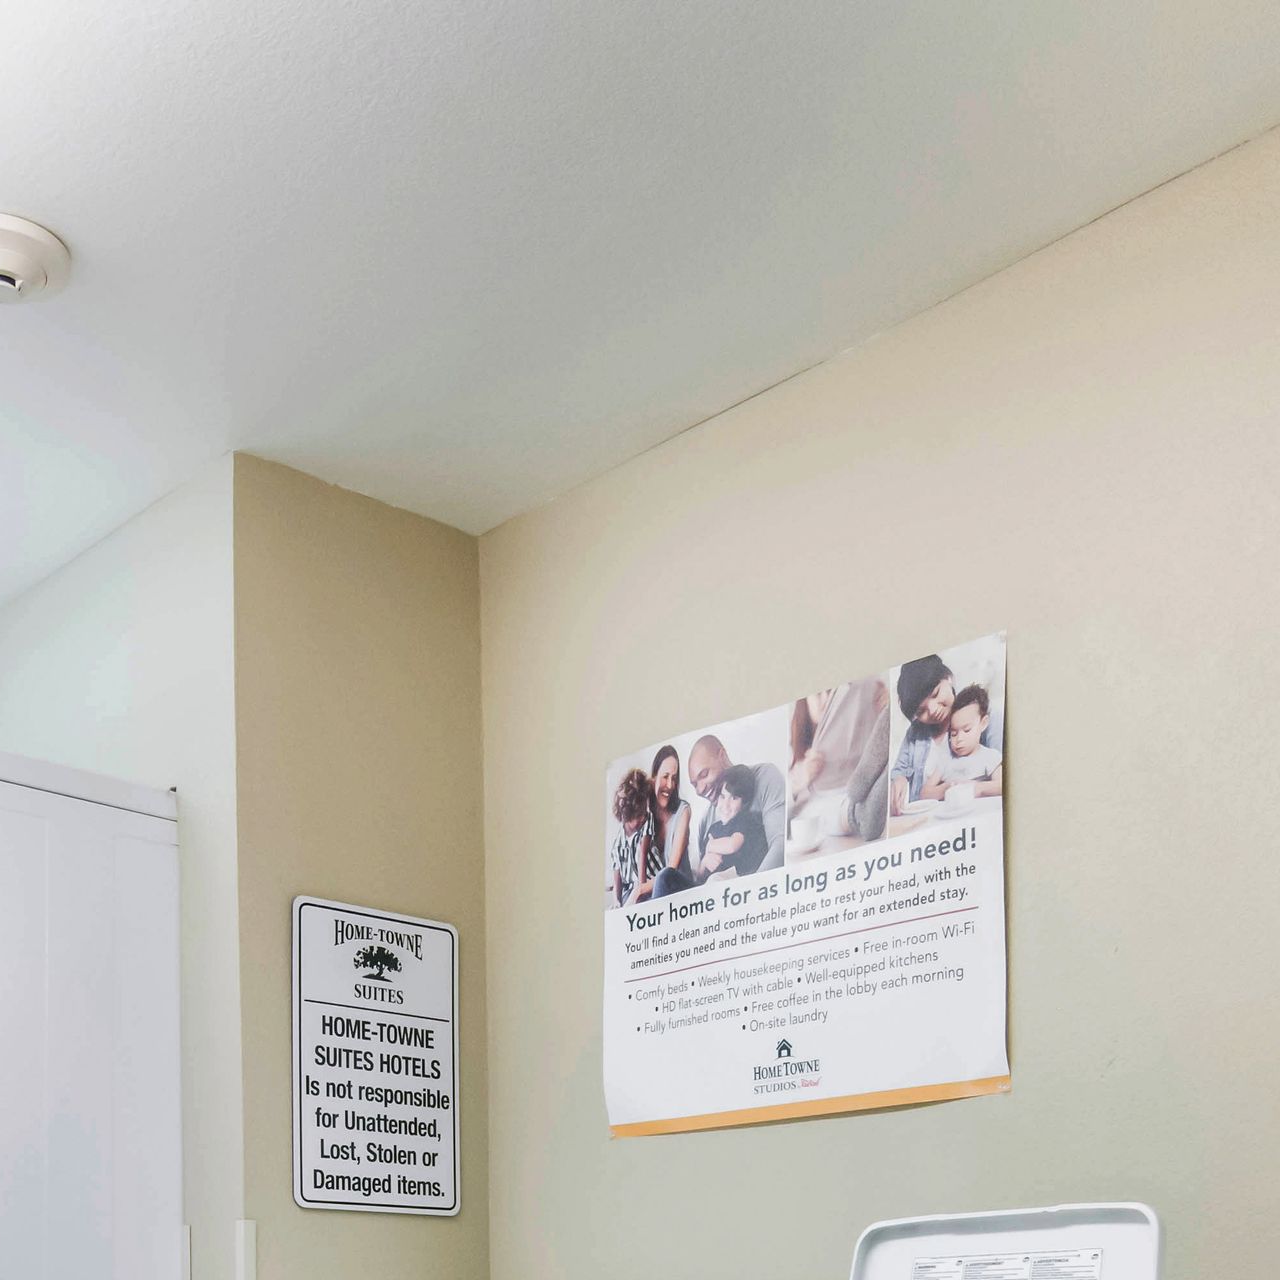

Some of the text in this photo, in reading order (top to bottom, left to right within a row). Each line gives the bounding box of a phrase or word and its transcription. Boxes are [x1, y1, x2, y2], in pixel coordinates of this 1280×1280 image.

[626, 827, 977, 932] Your home for as long as you need!
[625, 862, 977, 953] You'll find a clean and comfortable place to rest your head, with the
[334, 918, 423, 961] HOME-TOWNE
[630, 886, 969, 970] amenities you need and the value you want for an extended stay.
[635, 921, 975, 1002] Comfy beds Weekly housekeeping services Free in-room Wi-Fi
[354, 983, 404, 1005] SUITES
[662, 950, 939, 1013] HD flat-screen TV with cable Well-equipped kitchens
[644, 965, 964, 1035] Fully furnished rooms Free coffee in the lobby each morning
[321, 1015, 435, 1050] HOME-TOWNE
[750, 1007, 828, 1032] On-site laundry
[314, 1045, 441, 1080] SUITES HOTELS
[305, 1075, 450, 1111] Is not responsible
[753, 1080, 797, 1095] STUDIOS
[315, 1107, 442, 1142] for Unattended,
[320, 1138, 438, 1167] Lost, Stolen or
[313, 1169, 445, 1198] Damaged items.
